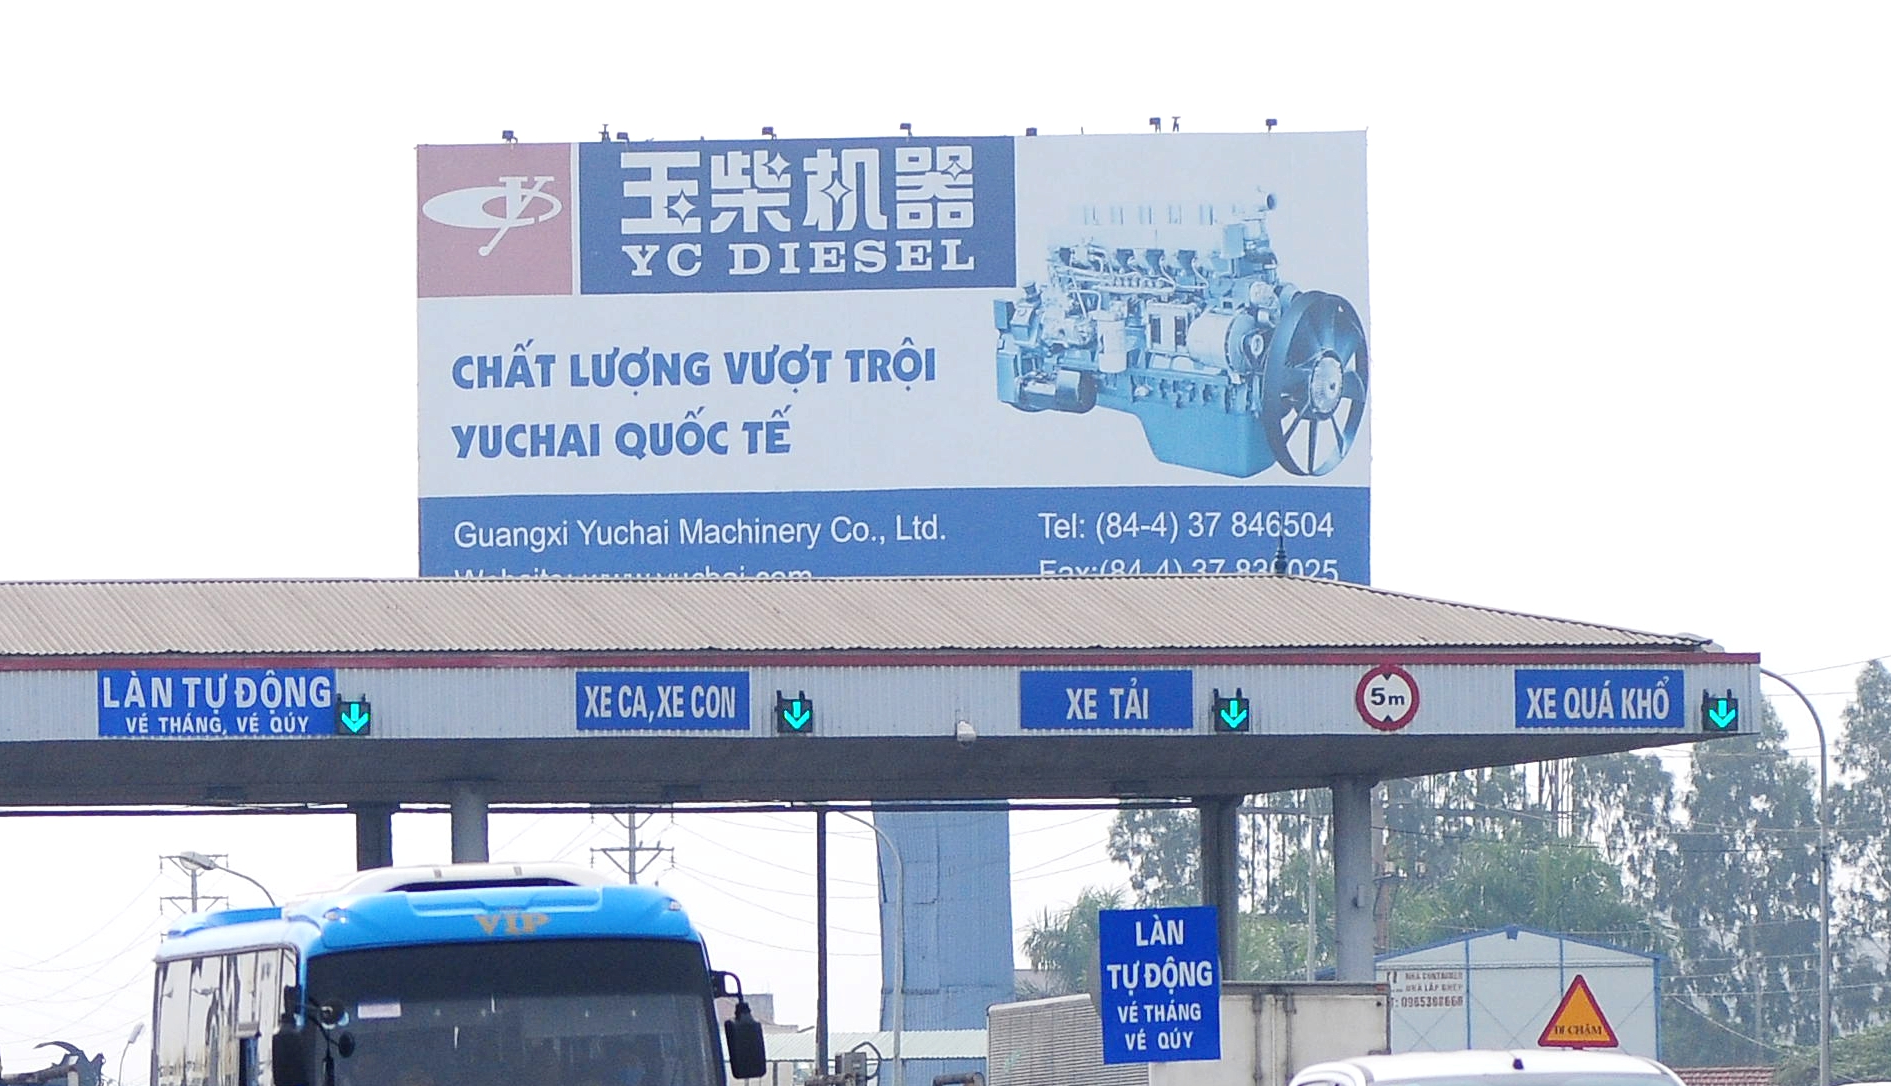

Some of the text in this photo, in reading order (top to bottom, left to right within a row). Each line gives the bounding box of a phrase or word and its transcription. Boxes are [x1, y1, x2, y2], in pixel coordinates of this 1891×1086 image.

[621, 146, 974, 234] 玉柴机器
[622, 239, 975, 276] YC DIESEL
[452, 337, 936, 397] CHẤT LƯỢNG VƯỢT TRỘI
[451, 404, 792, 460] YUCHAI QUỐC TẾ
[454, 514, 946, 554] Guangxi Yuchai Machinery Co., Ltd.
[1038, 511, 1334, 544] Tel: (84-4) 37 846504
[103, 670, 331, 714] LÀN TỰ ĐỘNG
[584, 685, 612, 718] XE
[690, 685, 736, 719] CON
[1066, 678, 1149, 720] XE TẢI
[1526, 675, 1670, 720] XE QUÁ KHỔ
[125, 711, 309, 735] VÉ THÁNG, VÉ QÚY
[474, 912, 550, 936] VIP
[1135, 914, 1186, 947] LÀN
[1106, 955, 1214, 996] TỰ ĐỘNG
[1116, 997, 1202, 1025] VÉ THÁNG
[1125, 1026, 1194, 1052] VÉ QÚY
